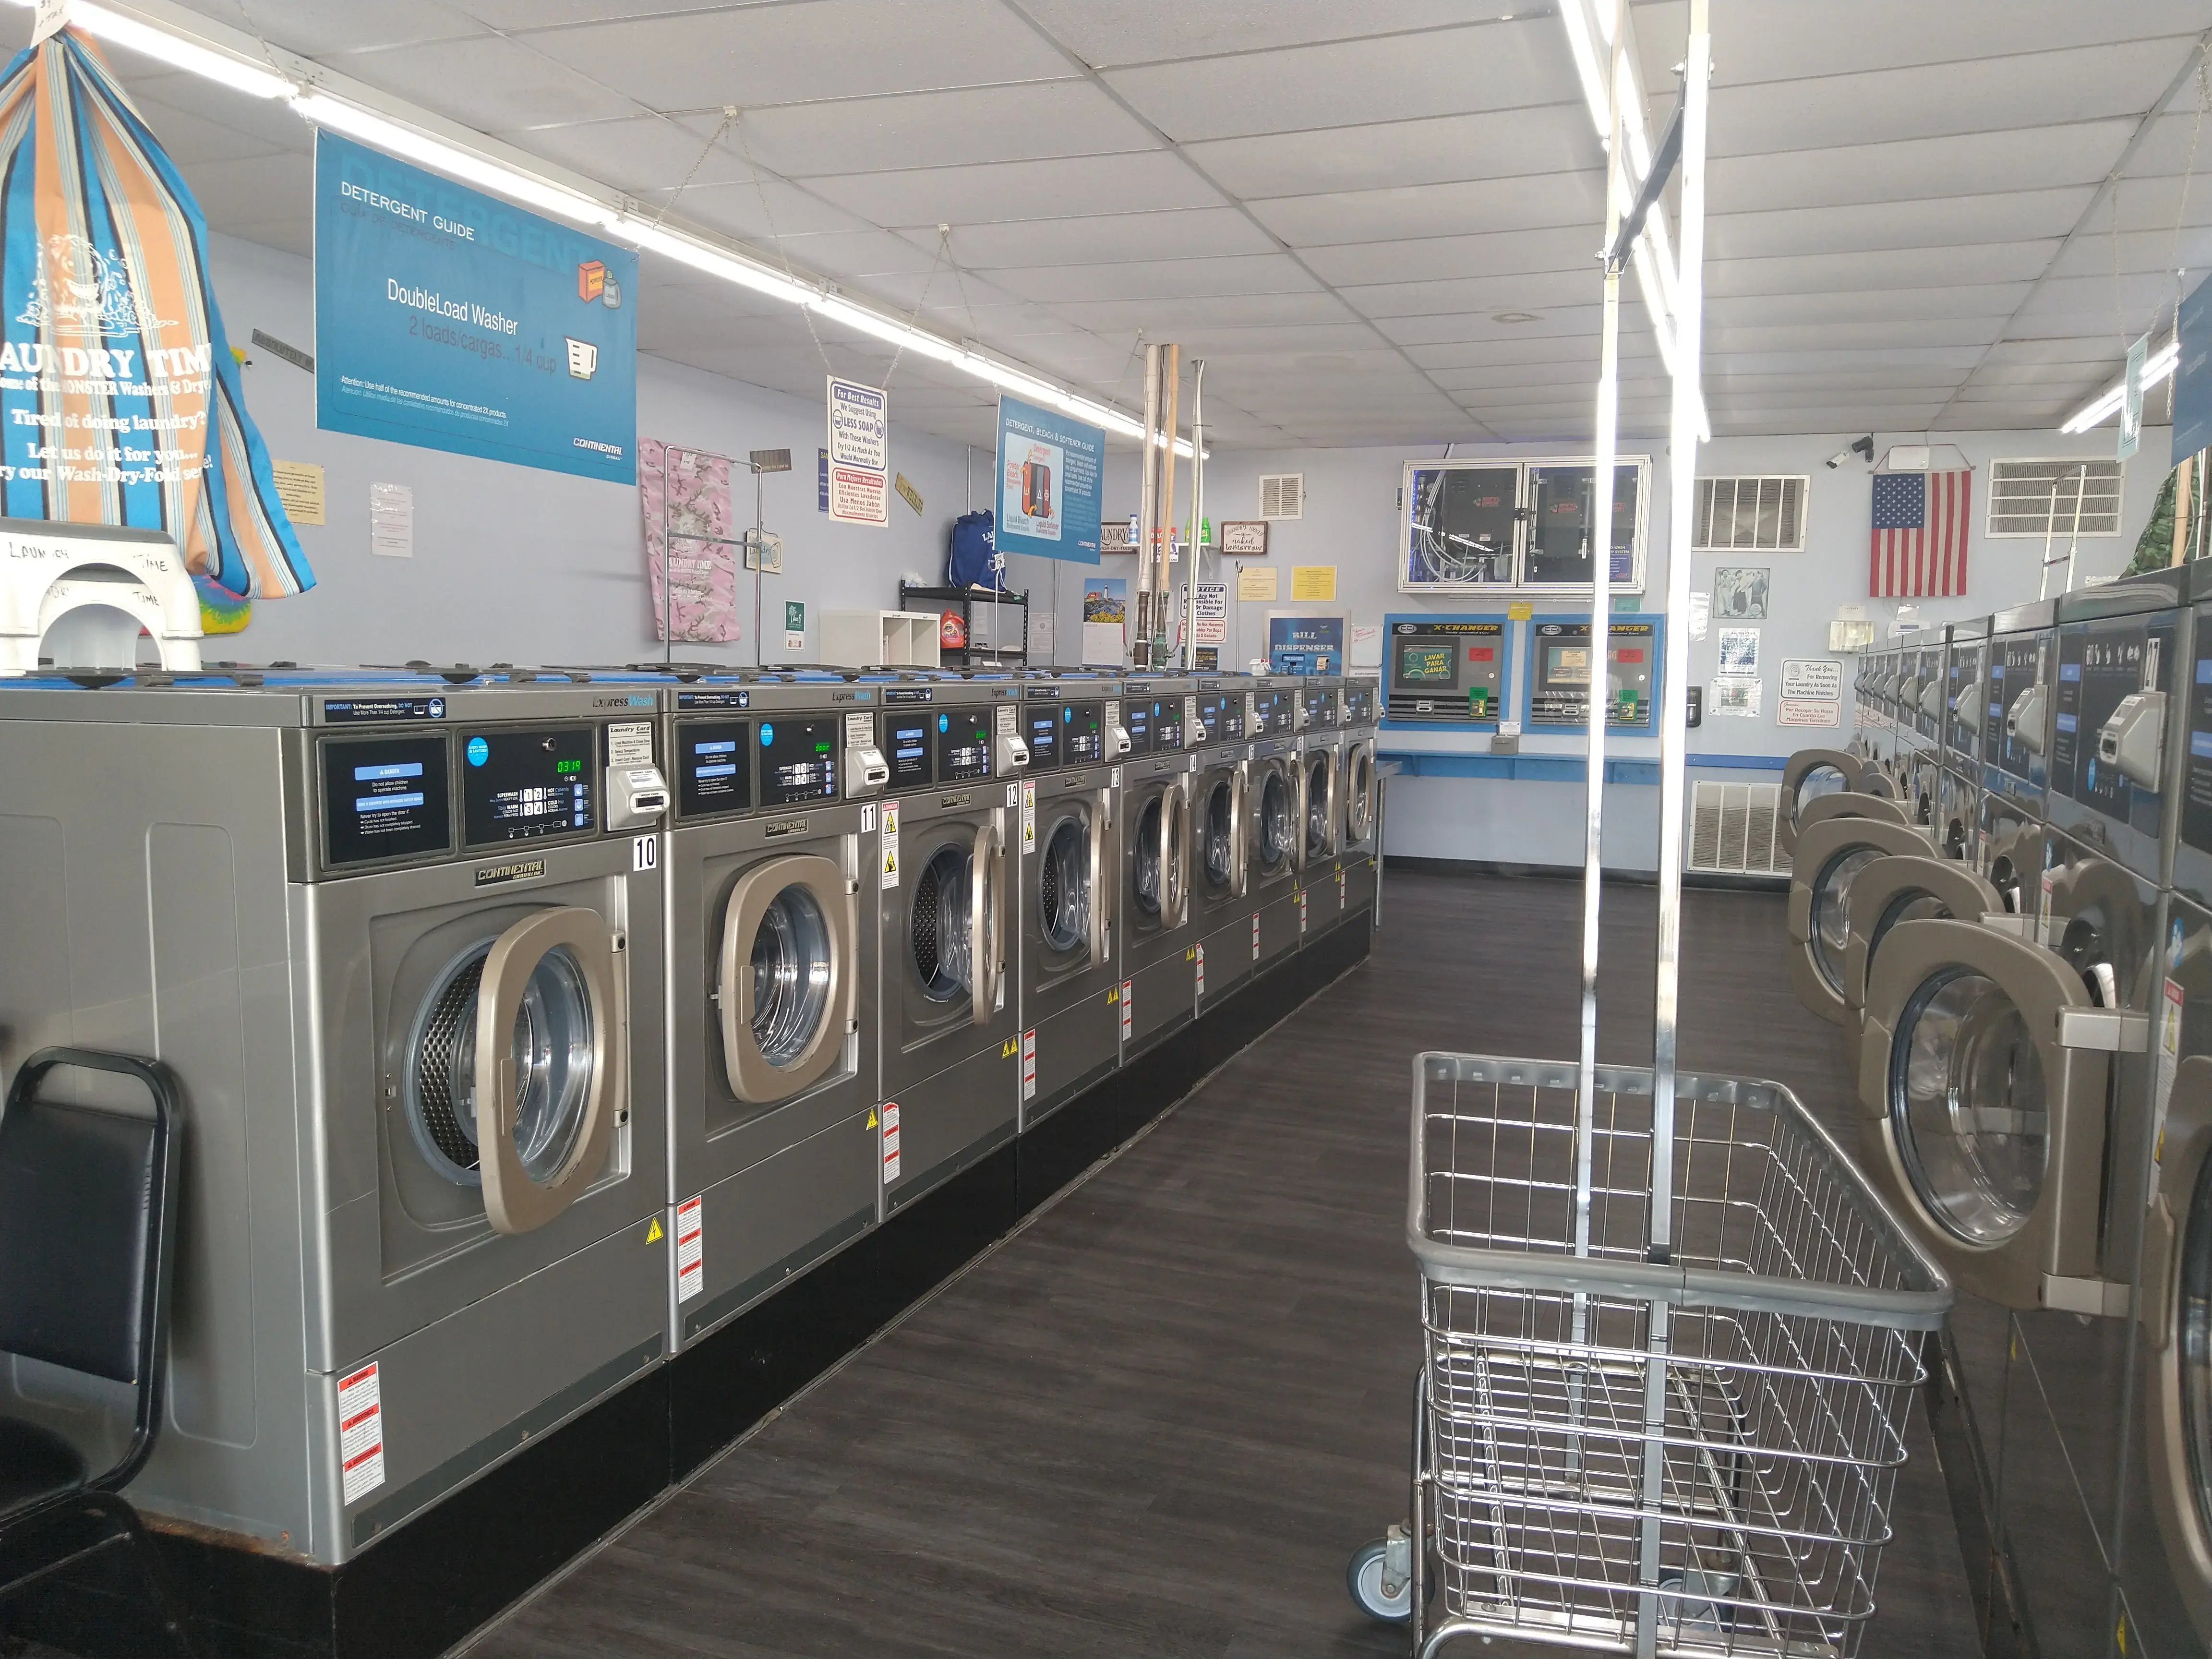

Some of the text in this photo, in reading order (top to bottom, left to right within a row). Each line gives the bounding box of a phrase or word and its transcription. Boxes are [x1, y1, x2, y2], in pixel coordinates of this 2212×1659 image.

[342, 181, 475, 241] DETERGENT GUIDE
[388, 278, 518, 336] DoubleLoad Washer
[0, 341, 212, 378] AUNDRY TIM
[537, 354, 557, 376] cup
[25, 377, 38, 390] of
[42, 378, 60, 391] the
[120, 381, 169, 397] Washers
[170, 381, 181, 394] &
[341, 375, 364, 387] Attention:
[365, 380, 374, 390] Use
[375, 383, 384, 391] half
[385, 385, 389, 393] of
[398, 389, 430, 401] recommended
[431, 396, 449, 406] amounts
[456, 402, 482, 413] concentrated
[837, 389, 879, 407] For Best Results
[841, 402, 877, 420] We Suggest Using
[11, 409, 206, 433] Tired of doing laundry?
[843, 416, 874, 433] LESS SOAP
[574, 437, 622, 455] CONTINENTAL
[839, 430, 879, 446] With These Washers
[1036, 427, 1053, 439] BLEACH
[1055, 433, 1058, 441] &
[1059, 435, 1081, 448] SOFTENER
[1082, 442, 1094, 453] GUIDE
[27, 442, 58, 459] Let
[62, 449, 81, 460] us
[84, 446, 105, 461] do
[106, 446, 122, 462] it
[123, 445, 152, 462] for
[841, 452, 852, 460] Would
[853, 455, 871, 466] Normally
[19, 464, 181, 485] our Wash-Dry-Fold
[847, 474, 862, 483] Mejores
[862, 477, 882, 486] Resultados
[839, 489, 881, 501] Eficientes Lavadoras
[848, 484, 866, 492] Nuestras
[850, 498, 865, 506] Menos
[1101, 528, 1128, 544] AUNDRY
[1232, 537, 1254, 545] naked
[1292, 631, 1317, 639] BILL
[1424, 653, 1444, 661] LAVAR
[1424, 666, 1447, 674] GANAR
[1190, 756, 1196, 771] 14
[1112, 769, 1119, 787] 13
[863, 805, 875, 831] 11
[637, 838, 655, 868] 10
[478, 861, 543, 880] CONTINENTAL
